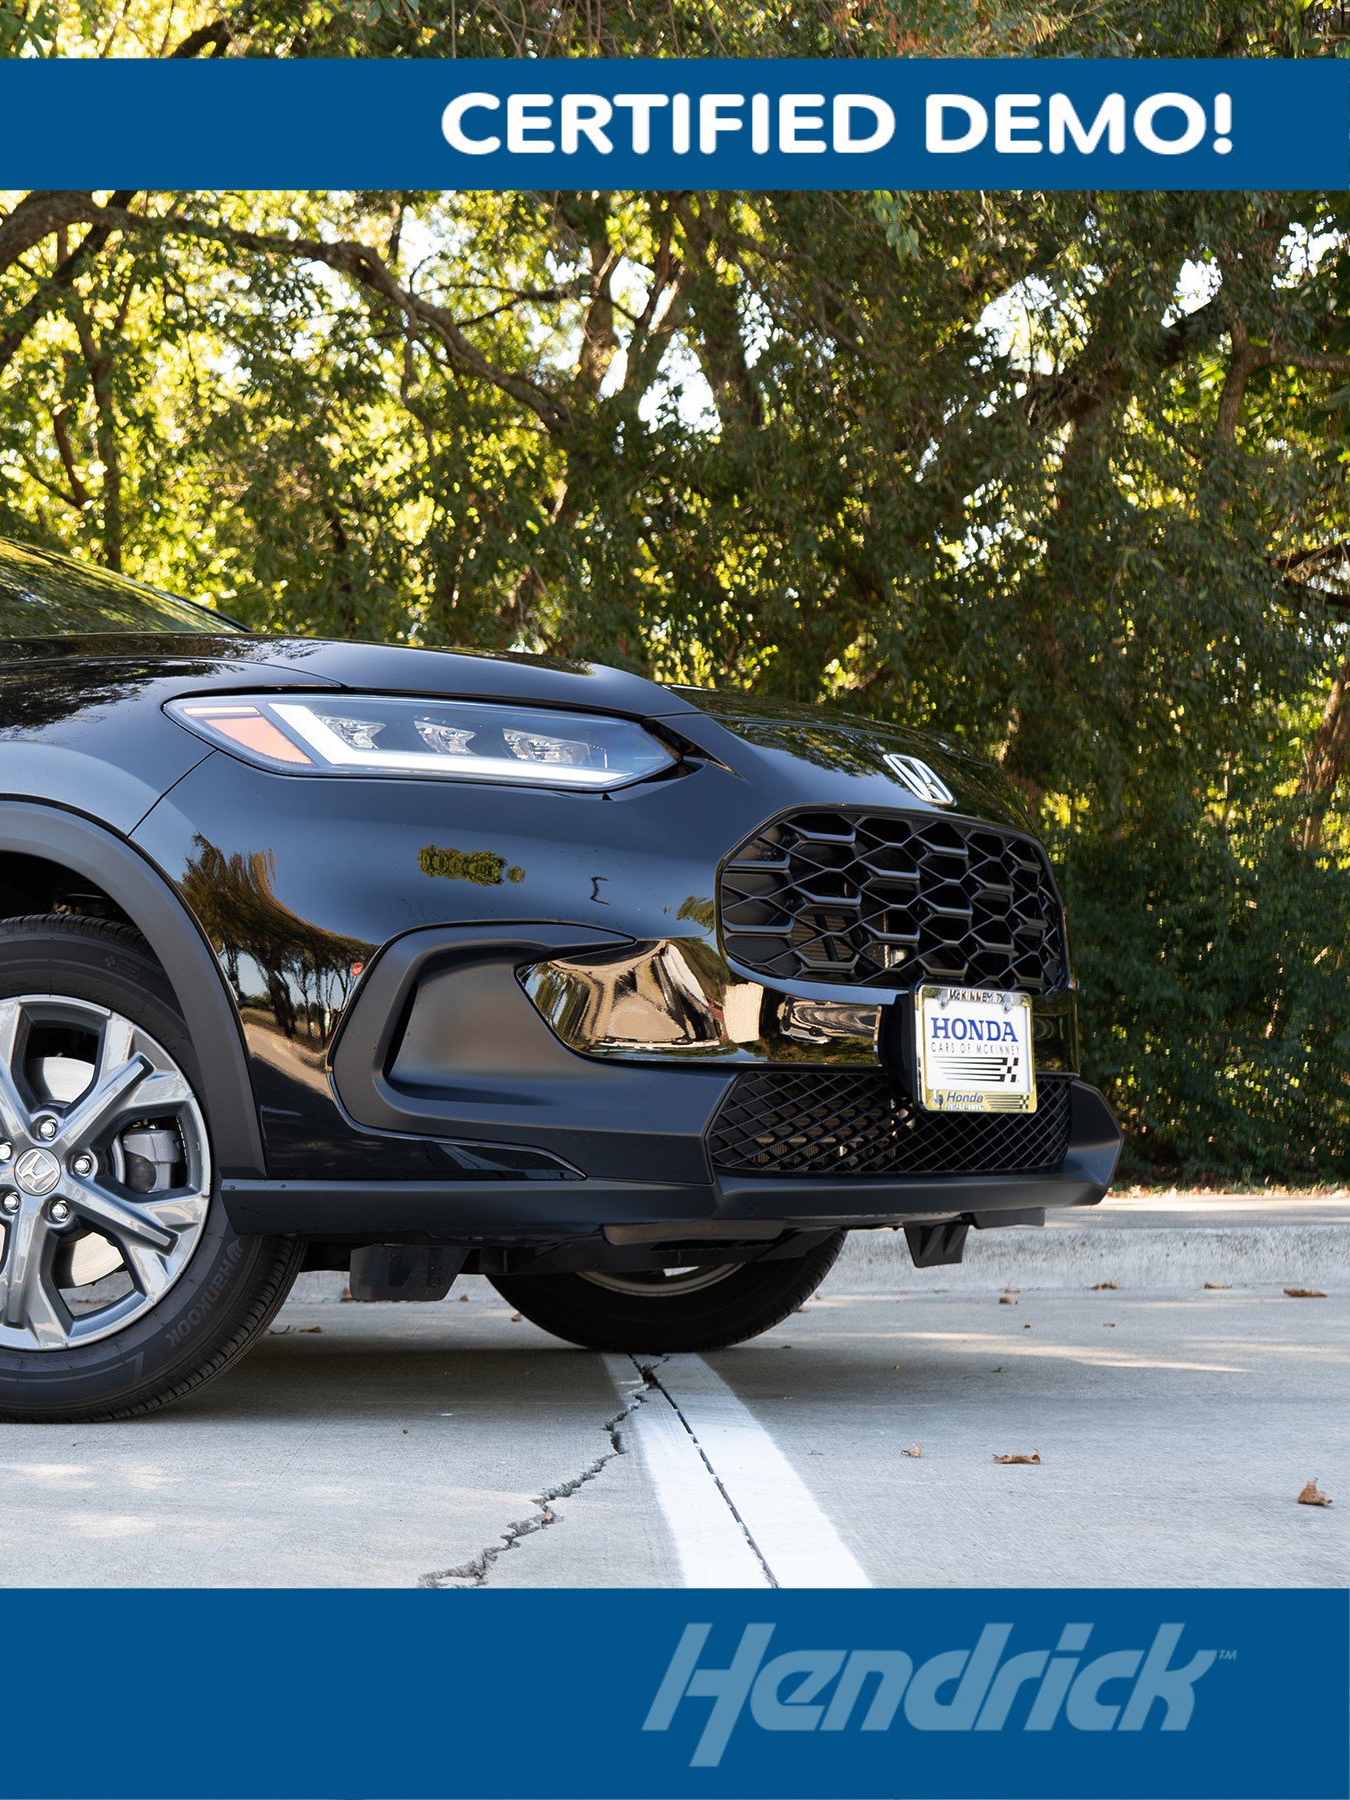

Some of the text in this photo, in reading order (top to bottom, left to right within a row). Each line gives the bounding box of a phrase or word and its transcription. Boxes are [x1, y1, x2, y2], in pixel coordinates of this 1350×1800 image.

[931, 1017, 1019, 1042] HONDA
[931, 1042, 955, 1053] CARS
[960, 1043, 971, 1053] OF
[946, 1091, 984, 1103] Honda
